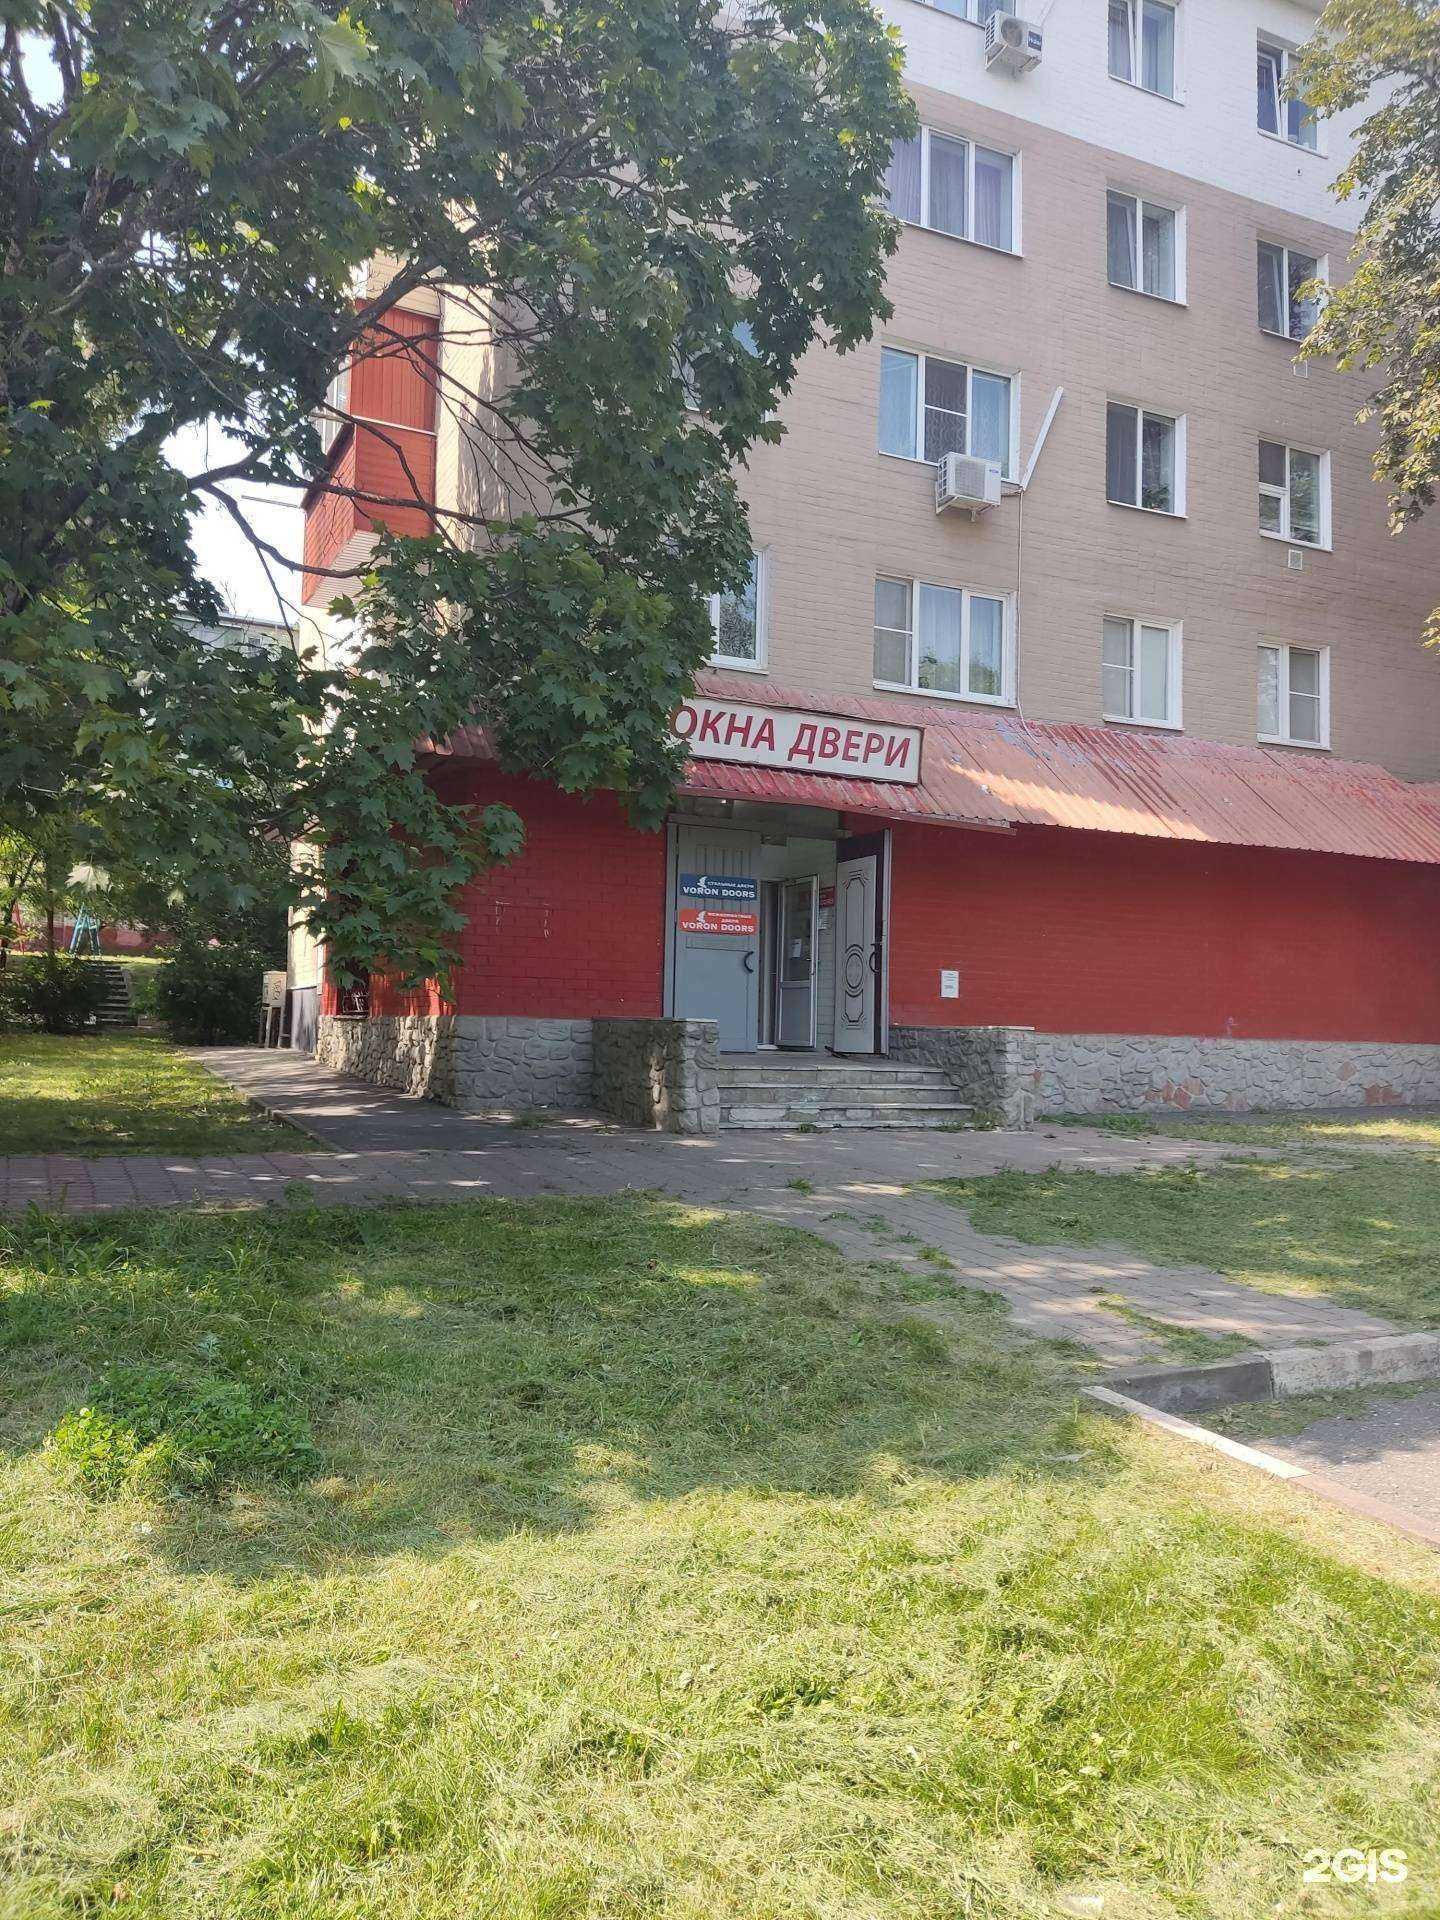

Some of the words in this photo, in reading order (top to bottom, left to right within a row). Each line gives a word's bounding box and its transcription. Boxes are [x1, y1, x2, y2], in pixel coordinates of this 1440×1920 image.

[669, 704, 776, 752] ОКНА
[787, 723, 911, 769] ДВЕРИ
[683, 886, 719, 896] VORON
[722, 889, 755, 898] DOORS
[681, 921, 718, 931] VORON
[721, 924, 755, 933] DOORS
